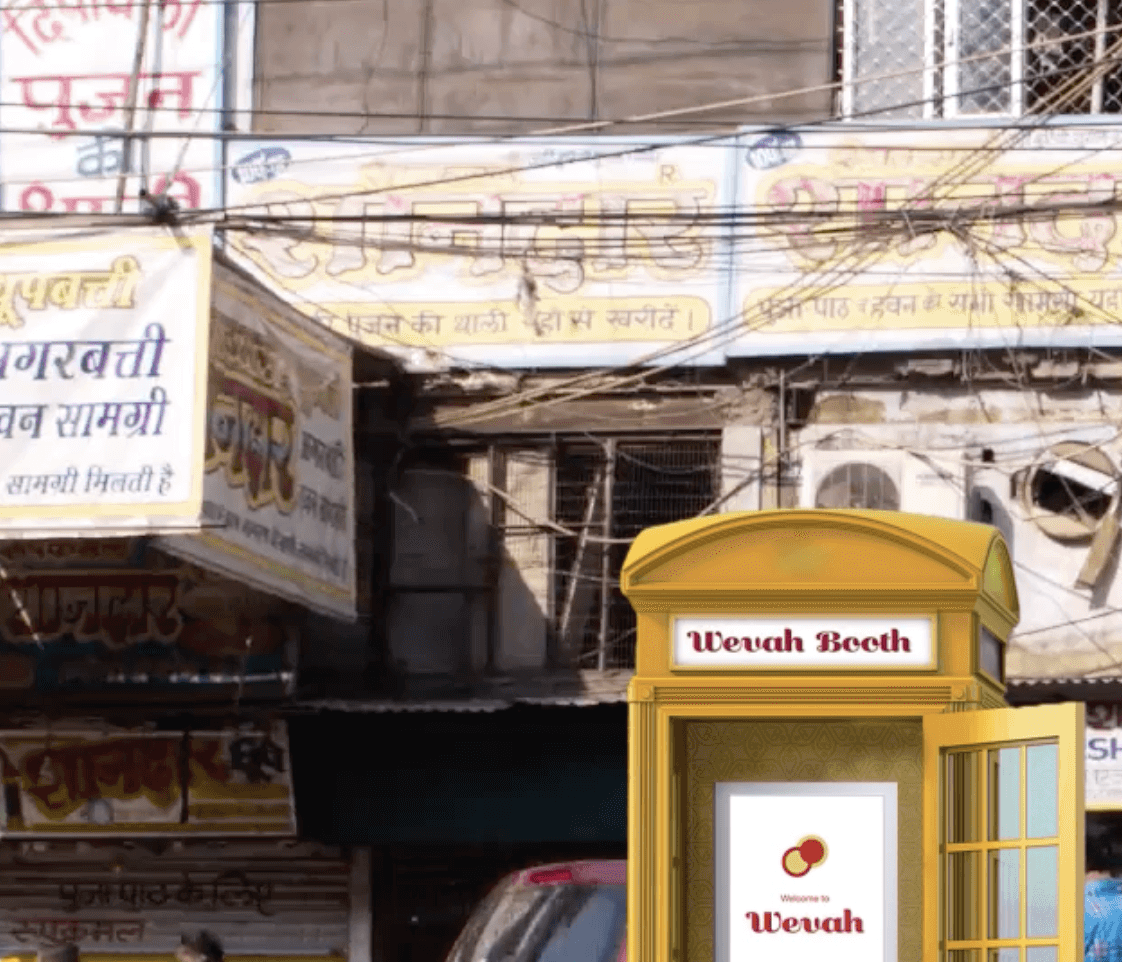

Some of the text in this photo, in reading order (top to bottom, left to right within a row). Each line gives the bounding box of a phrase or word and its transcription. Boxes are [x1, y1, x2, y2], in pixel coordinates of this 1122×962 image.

[0, 386, 171, 439] वन सामग्री
[158, 463, 175, 497] है
[687, 627, 912, 653] Wevah Booth
[780, 894, 830, 903] Welcome to
[745, 908, 865, 934] Wevah
